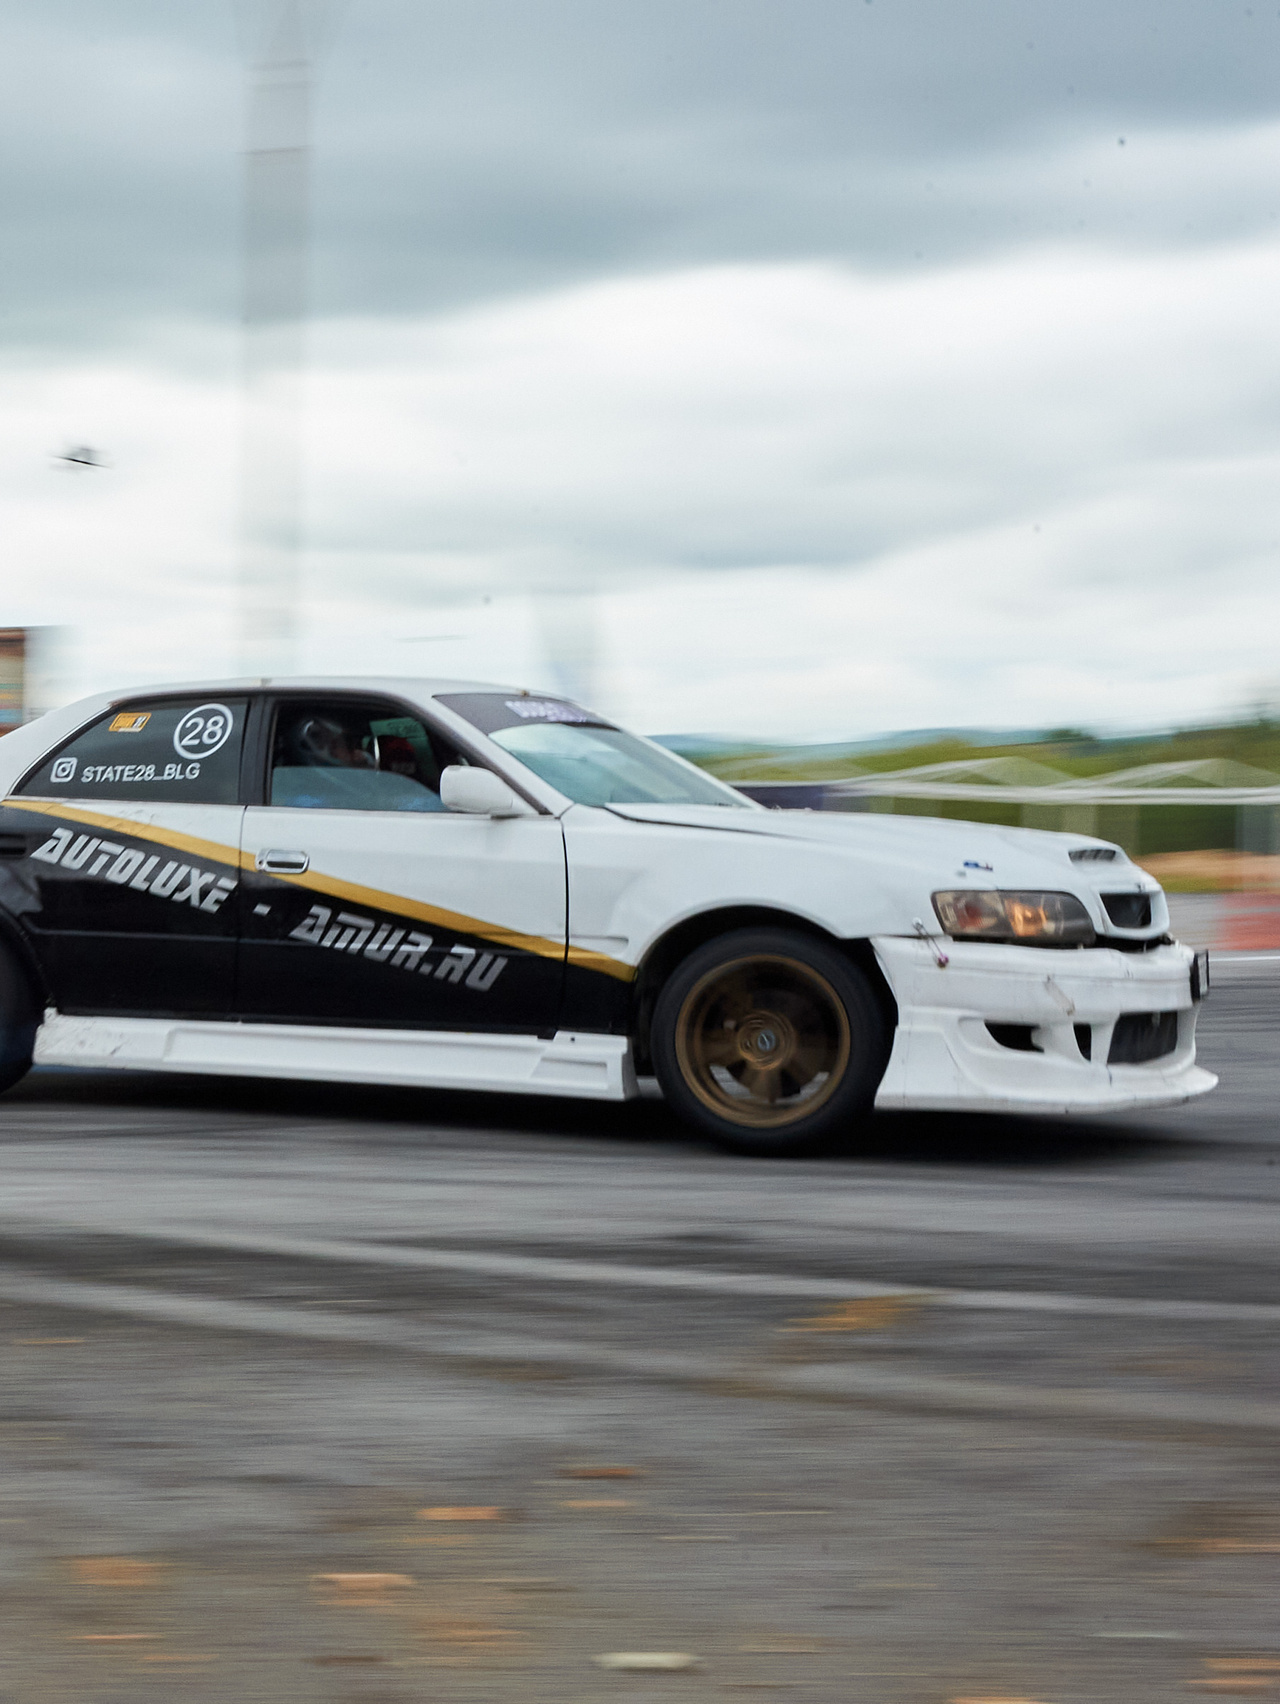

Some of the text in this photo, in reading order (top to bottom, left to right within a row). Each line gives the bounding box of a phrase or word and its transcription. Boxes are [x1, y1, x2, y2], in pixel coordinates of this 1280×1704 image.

[181, 715, 225, 746] 28
[81, 762, 200, 783] STATE28_BLG
[30, 828, 237, 914] AUTOLUXE
[289, 904, 508, 991] AMUR.RU
